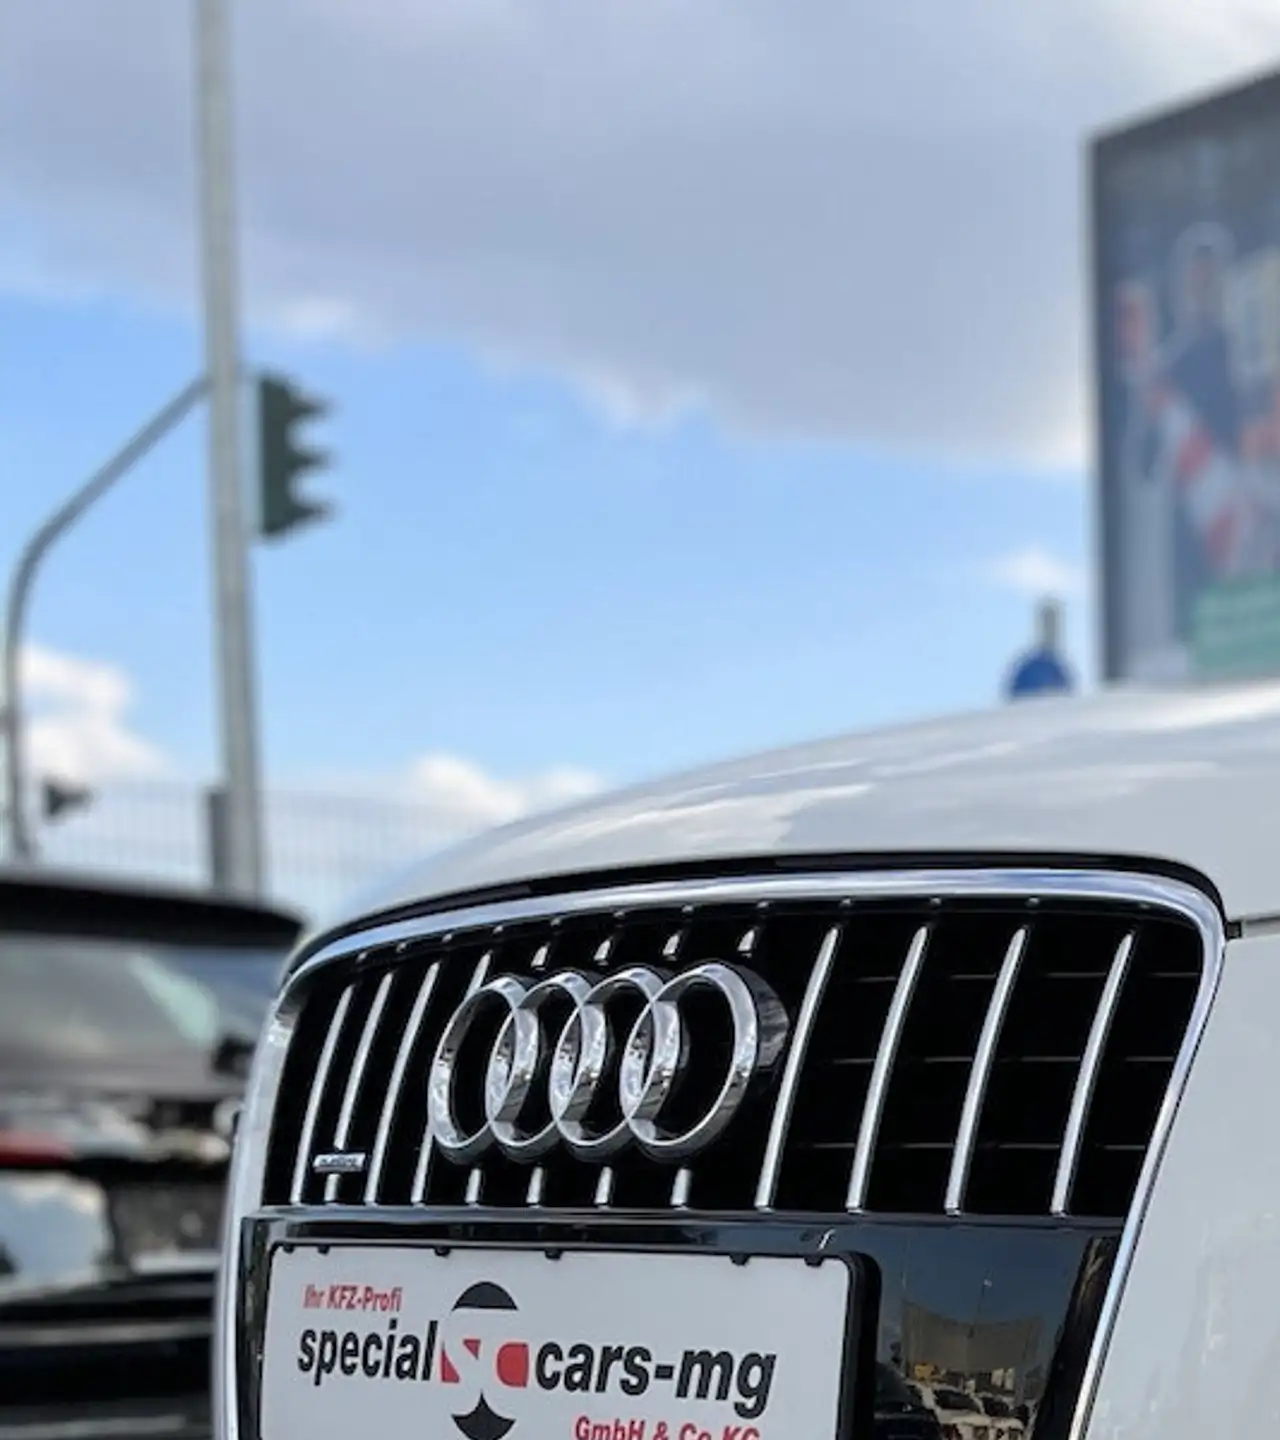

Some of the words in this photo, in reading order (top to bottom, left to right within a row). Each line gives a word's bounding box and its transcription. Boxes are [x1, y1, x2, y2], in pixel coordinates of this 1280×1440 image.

[303, 1284, 325, 1309] Ihr
[327, 1285, 403, 1312] KFZ-Profi
[298, 1318, 439, 1387] special
[534, 1341, 777, 1420] cars-mg
